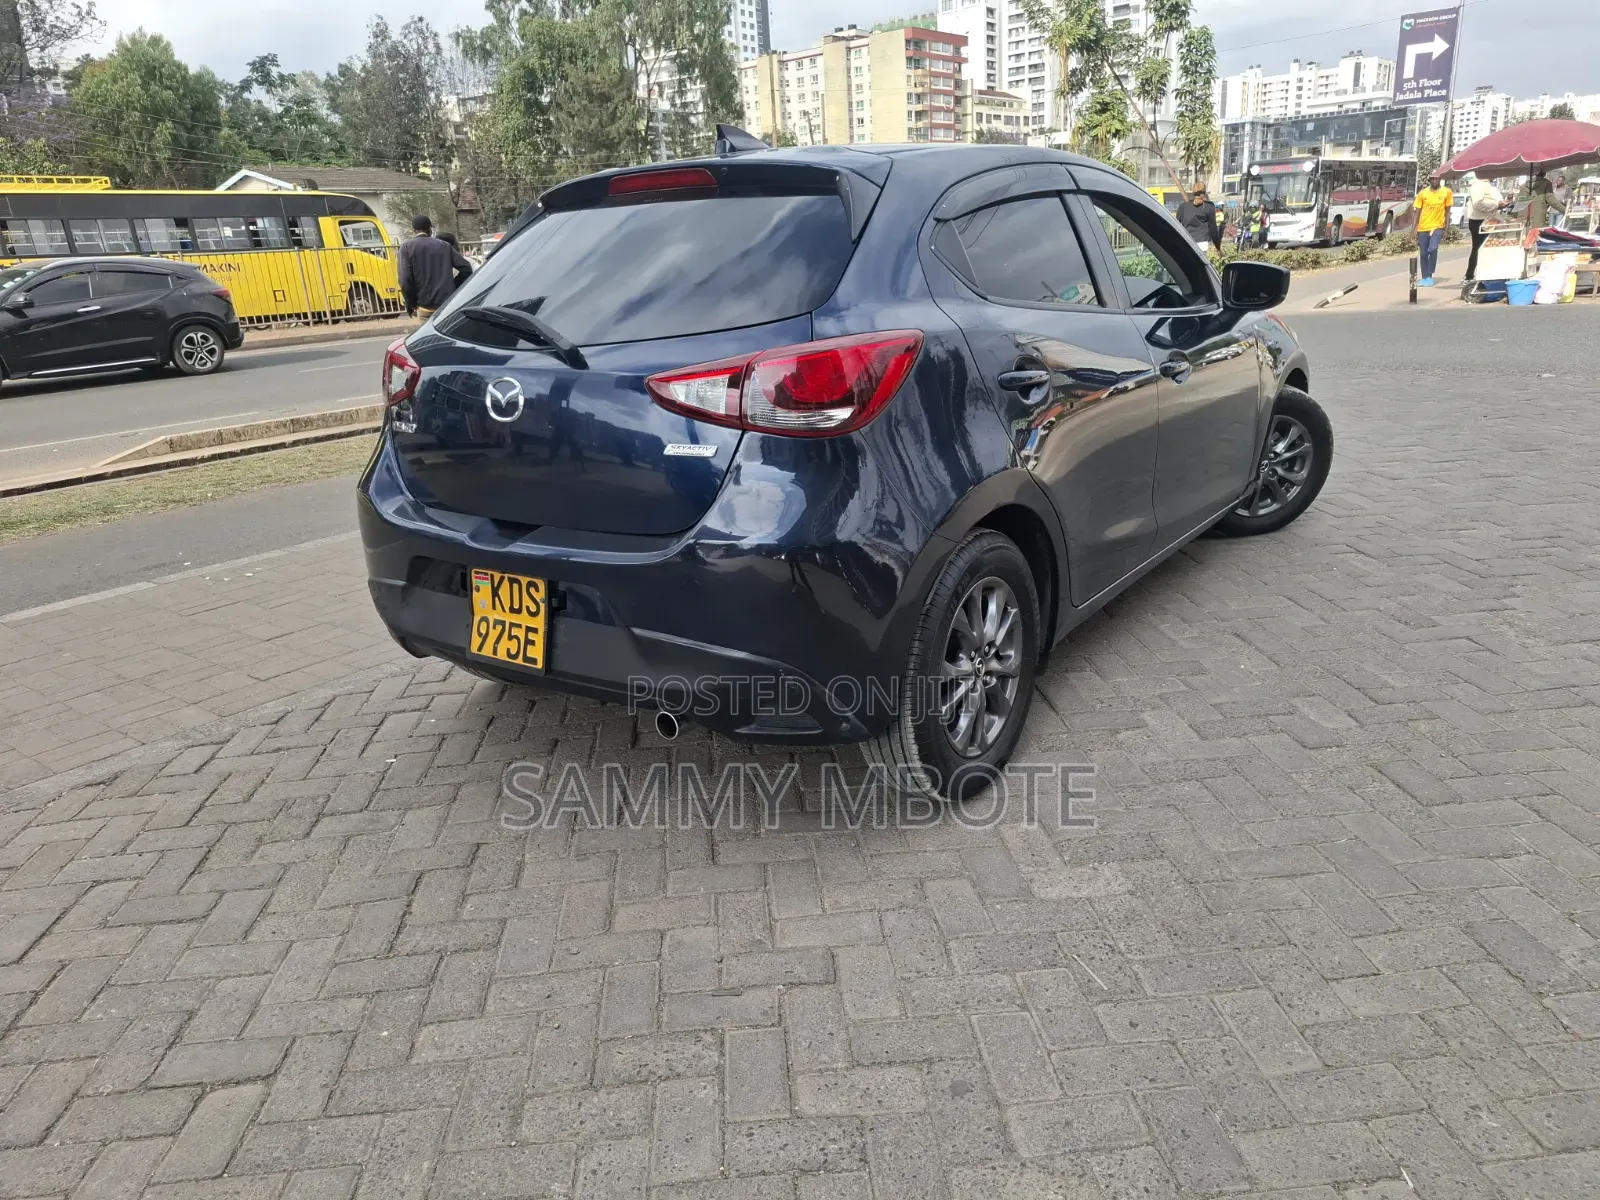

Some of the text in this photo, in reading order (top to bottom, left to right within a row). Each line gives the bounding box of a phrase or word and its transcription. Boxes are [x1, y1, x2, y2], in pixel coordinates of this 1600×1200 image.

[1395, 89, 1447, 101] Jadala Place
[1403, 78, 1442, 90] 5th Floor
[489, 573, 541, 618] KDS
[476, 615, 539, 666] 975E
